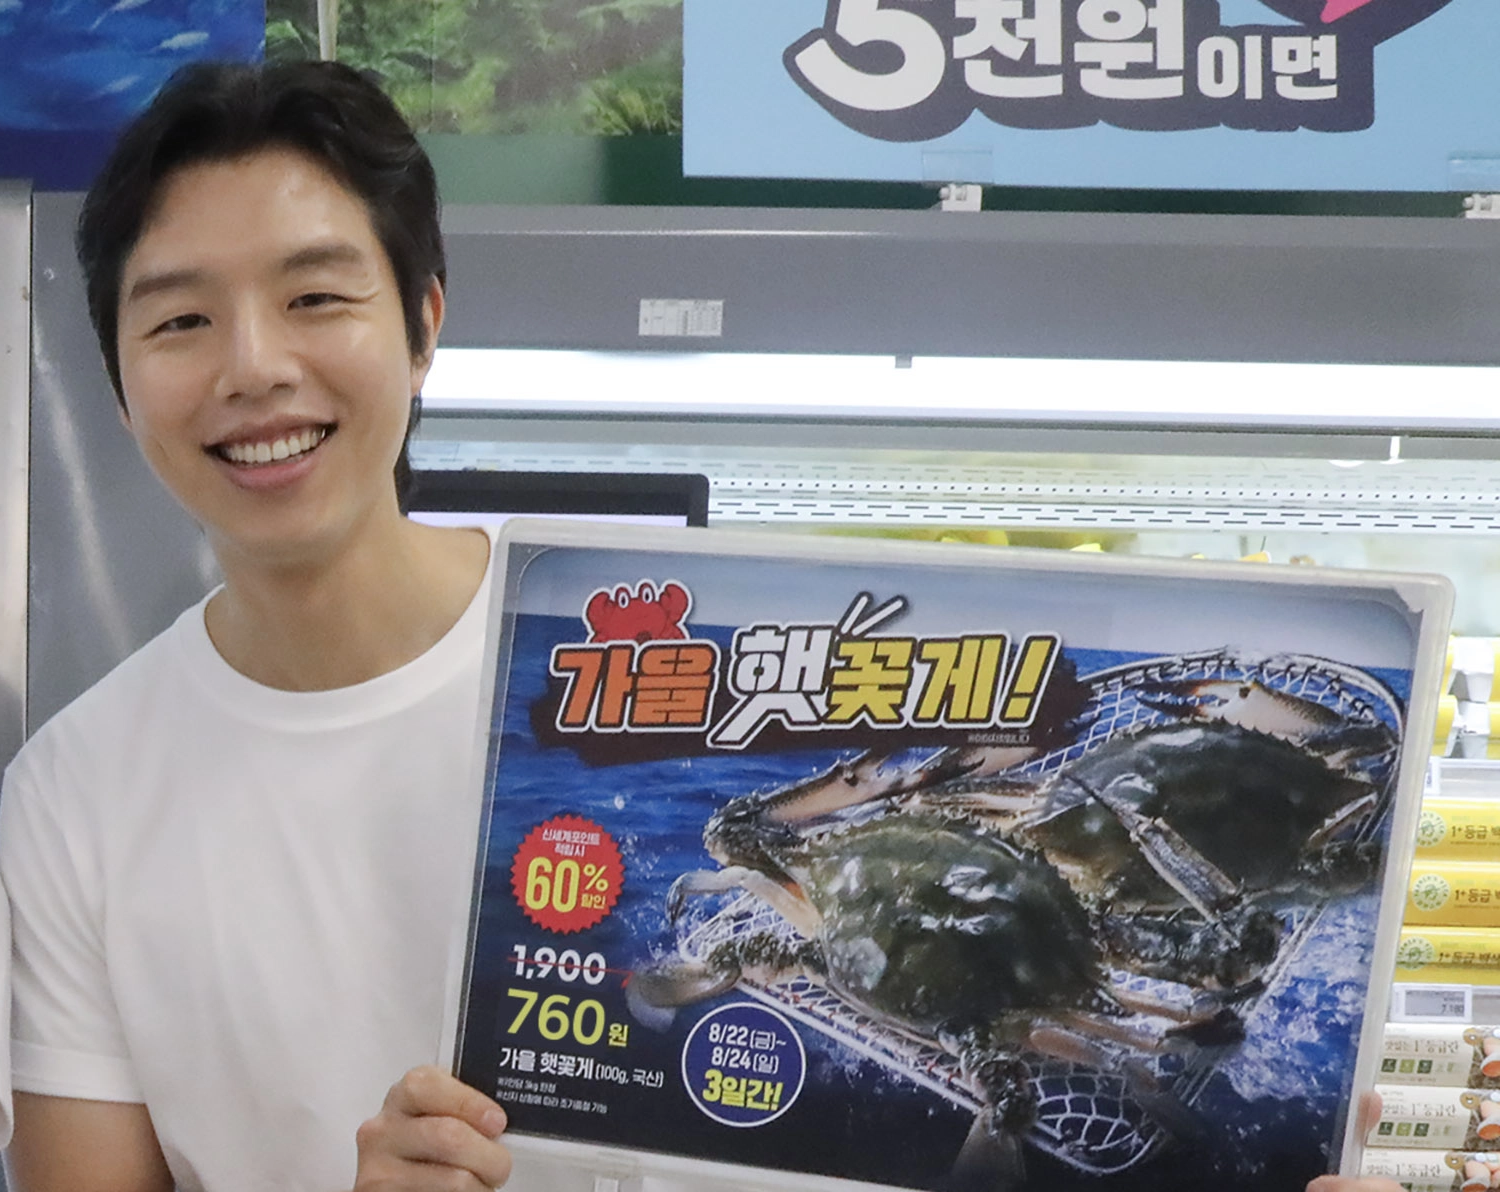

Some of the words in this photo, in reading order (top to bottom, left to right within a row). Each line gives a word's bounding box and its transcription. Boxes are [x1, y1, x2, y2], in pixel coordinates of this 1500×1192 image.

[553, 644, 717, 730] 가을
[709, 622, 1057, 747] 햇꽃게!
[525, 857, 609, 913] 60%
[581, 893, 606, 909] 할인
[514, 944, 606, 985] 1,900
[500, 1047, 536, 1072] 가을
[540, 1052, 594, 1080] 햇꽃게
[702, 1069, 784, 1111] 3일간!
